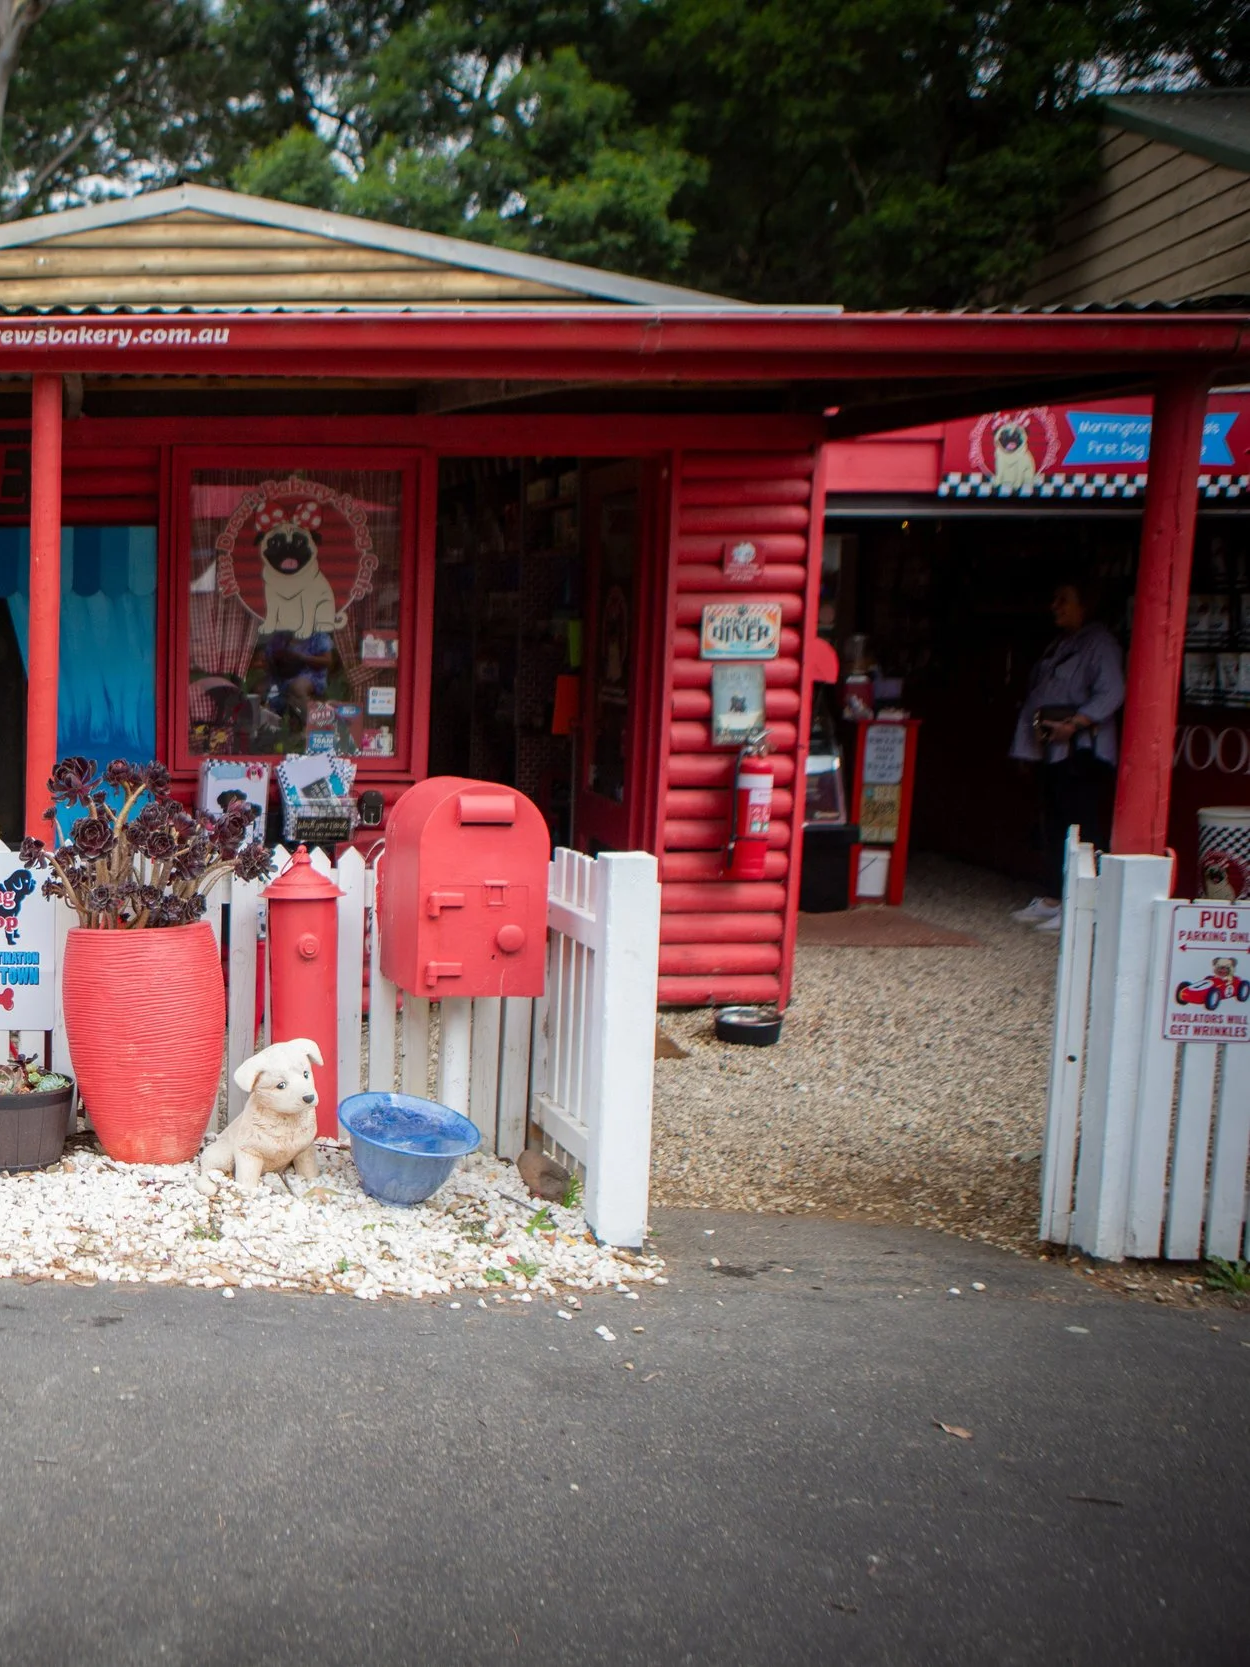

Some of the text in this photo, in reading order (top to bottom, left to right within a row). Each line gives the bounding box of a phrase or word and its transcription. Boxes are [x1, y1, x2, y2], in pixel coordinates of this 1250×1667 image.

[1121, 440, 1146, 460] Dog
[261, 475, 336, 503] Bakery
[348, 506, 373, 550] Dog
[712, 622, 770, 642] DINER
[1173, 724, 1250, 775] OO
[1199, 910, 1238, 929] PUG
[1178, 930, 1250, 943] PARKING ONL
[0, 967, 40, 986] TOWN
[1172, 1012, 1248, 1025] VIOLATORS WILL
[1170, 1024, 1247, 1037] GET WRINKLES
